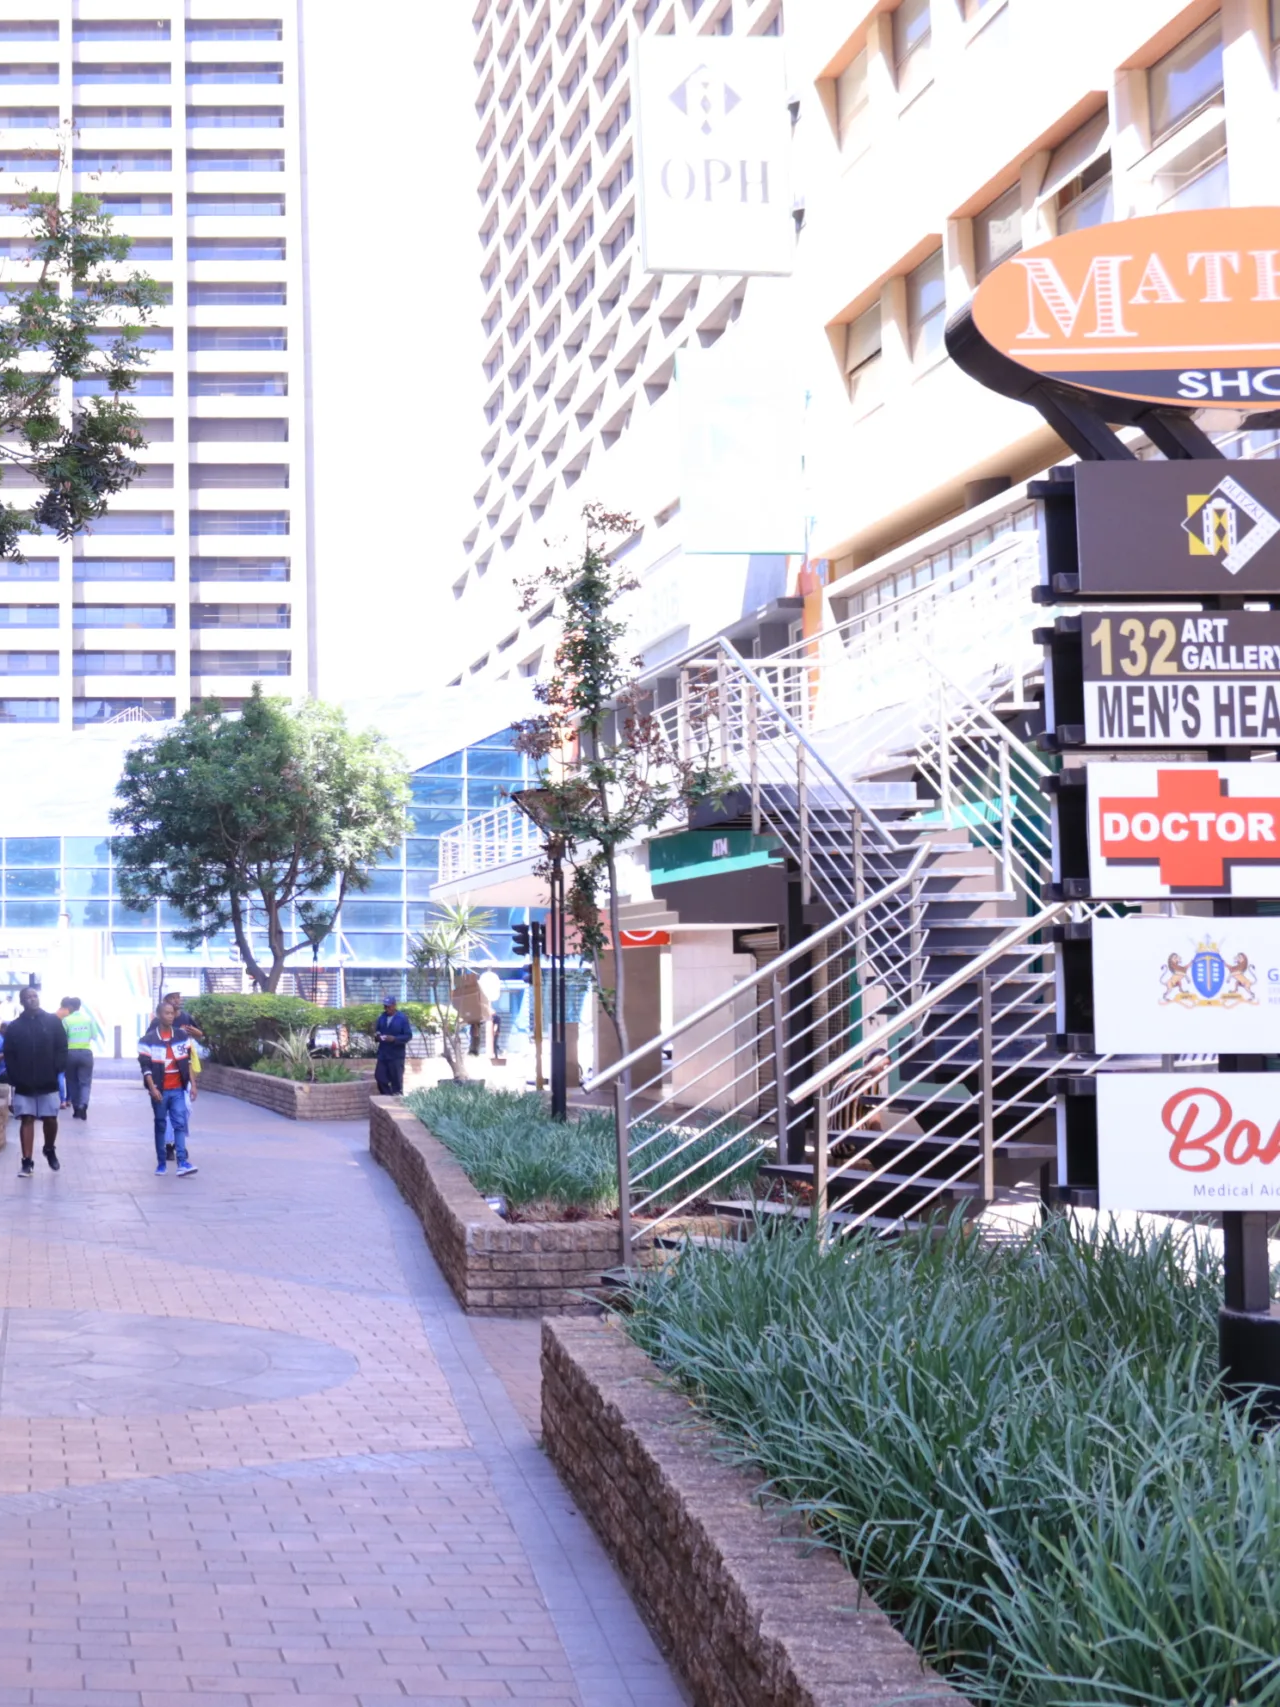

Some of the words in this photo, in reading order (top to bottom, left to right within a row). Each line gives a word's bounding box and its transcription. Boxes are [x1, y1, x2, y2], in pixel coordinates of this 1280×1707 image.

[660, 157, 770, 204] OPH
[1091, 618, 1178, 676] 132
[1181, 618, 1228, 643] ART
[1182, 645, 1280, 670] GALLER
[1097, 684, 1201, 738] MEN'S
[1213, 684, 1280, 738] HEA
[1103, 811, 1277, 842] DOCTOR
[712, 837, 728, 857] ATM
[1193, 1182, 1254, 1197] Medical
